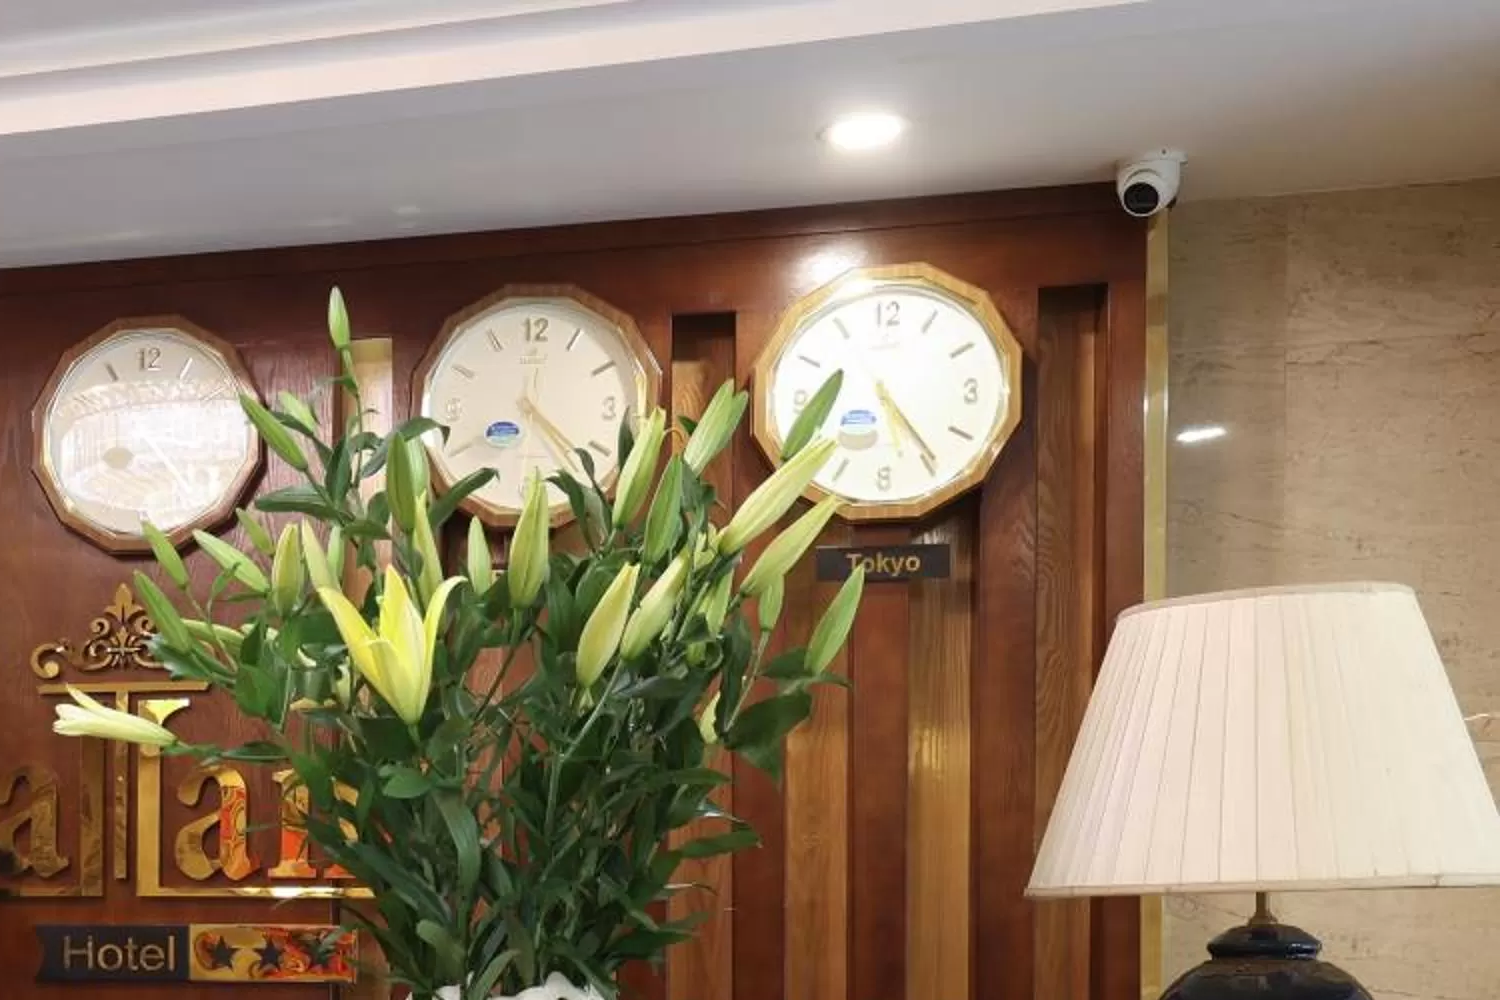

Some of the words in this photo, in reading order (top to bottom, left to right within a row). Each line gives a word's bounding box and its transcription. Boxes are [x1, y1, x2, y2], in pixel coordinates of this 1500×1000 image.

[875, 301, 901, 326] 12
[521, 317, 549, 342] 12
[137, 347, 162, 371] 12
[963, 378, 979, 405] 3
[601, 396, 617, 420] 3
[876, 466, 891, 491] 6
[846, 552, 921, 577] Tokyo
[63, 934, 176, 971] Hotel
